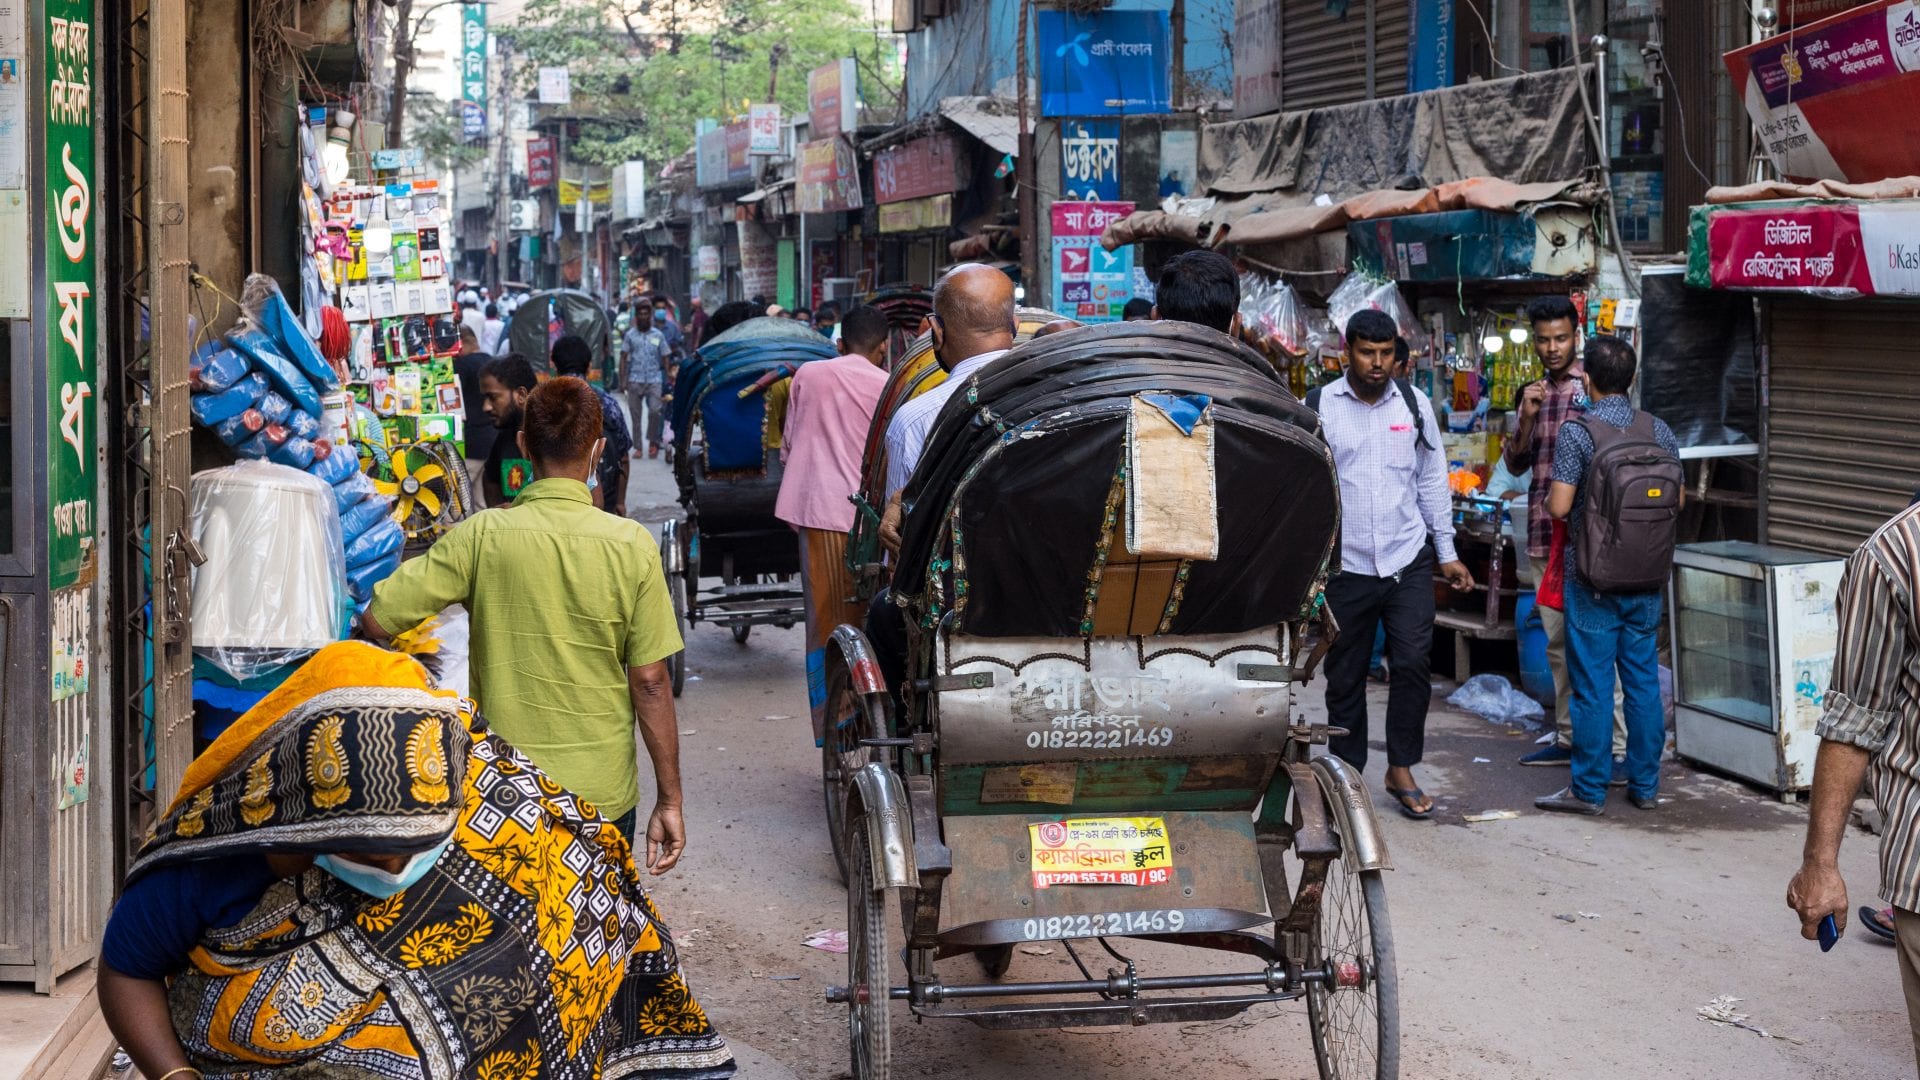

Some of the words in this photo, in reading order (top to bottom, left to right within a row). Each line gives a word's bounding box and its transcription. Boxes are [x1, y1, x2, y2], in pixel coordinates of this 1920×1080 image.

[1064, 213, 1084, 231] মা
[1764, 218, 1812, 246] ডিজিটাল
[1743, 251, 1801, 280] রেজিস্ট্রেশন
[1804, 252, 1835, 279] পয়েন্ট
[1889, 243, 1920, 270] bKas
[1051, 710, 1143, 730] পরিবহন
[1026, 727, 1174, 749] 01822221469
[1034, 843, 1126, 867] ক্যামব্রিয়ান
[1131, 845, 1165, 868] স্কুল
[1024, 909, 1185, 940] 01822221469
